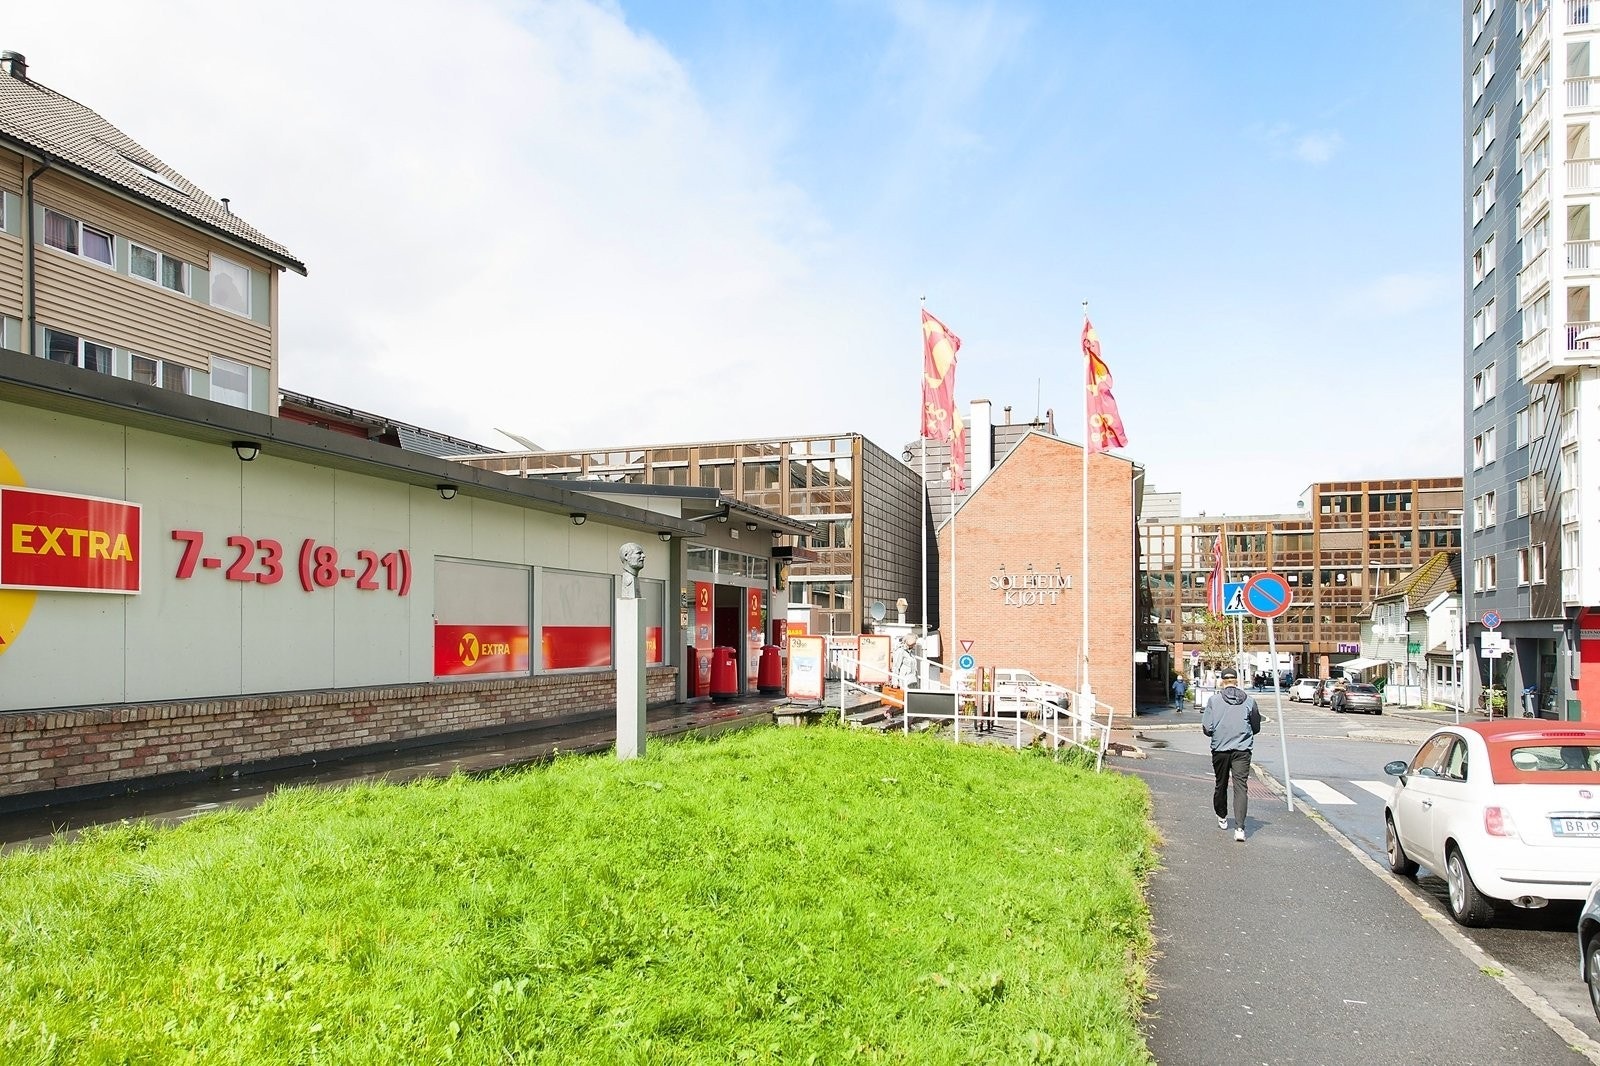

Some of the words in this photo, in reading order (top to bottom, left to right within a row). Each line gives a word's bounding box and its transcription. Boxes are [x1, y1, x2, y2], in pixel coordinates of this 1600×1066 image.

[12, 523, 134, 561] EXTRA
[172, 530, 284, 584] 7-23
[298, 538, 412, 597] (8-21)
[989, 574, 1073, 590] SOLHEIM
[1004, 591, 1059, 608] KJØTT
[482, 643, 511, 655] EXTRA
[646, 640, 657, 651] TRA
